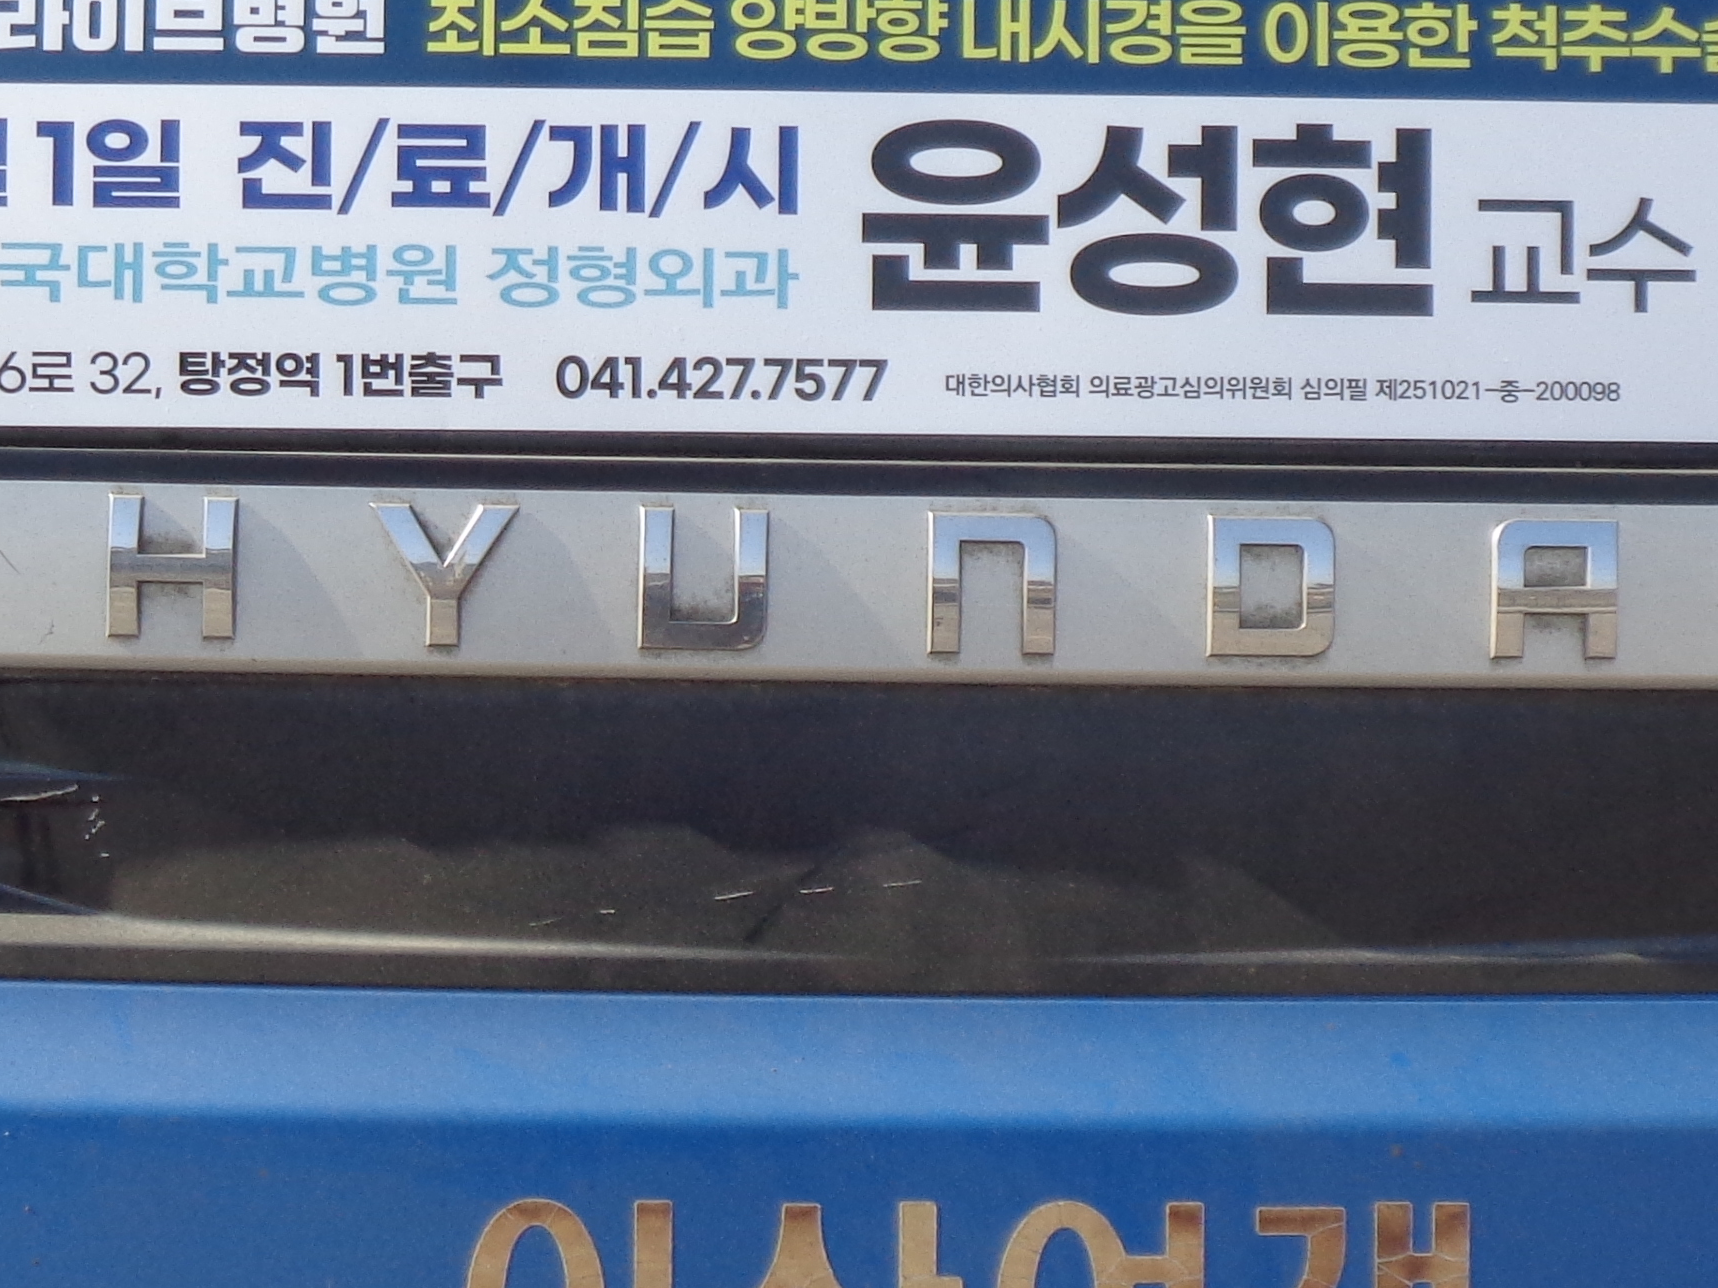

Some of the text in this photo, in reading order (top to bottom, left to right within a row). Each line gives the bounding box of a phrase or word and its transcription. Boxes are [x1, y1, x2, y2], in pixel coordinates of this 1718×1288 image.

[1263, 0, 1477, 70] 이용한
[236, 117, 798, 218] 진/료/개/시
[861, 116, 1698, 317] 윤성현 교수
[487, 244, 799, 310] 정형외과
[89, 350, 161, 399] 32,
[178, 350, 321, 398] 탕정역
[335, 351, 503, 399] 1번출구
[555, 354, 888, 402] 041.427.7577
[944, 373, 1081, 399] 대한의사협회
[1088, 374, 1293, 401] 의료광고심의위원회
[1299, 376, 1369, 402] 심의필
